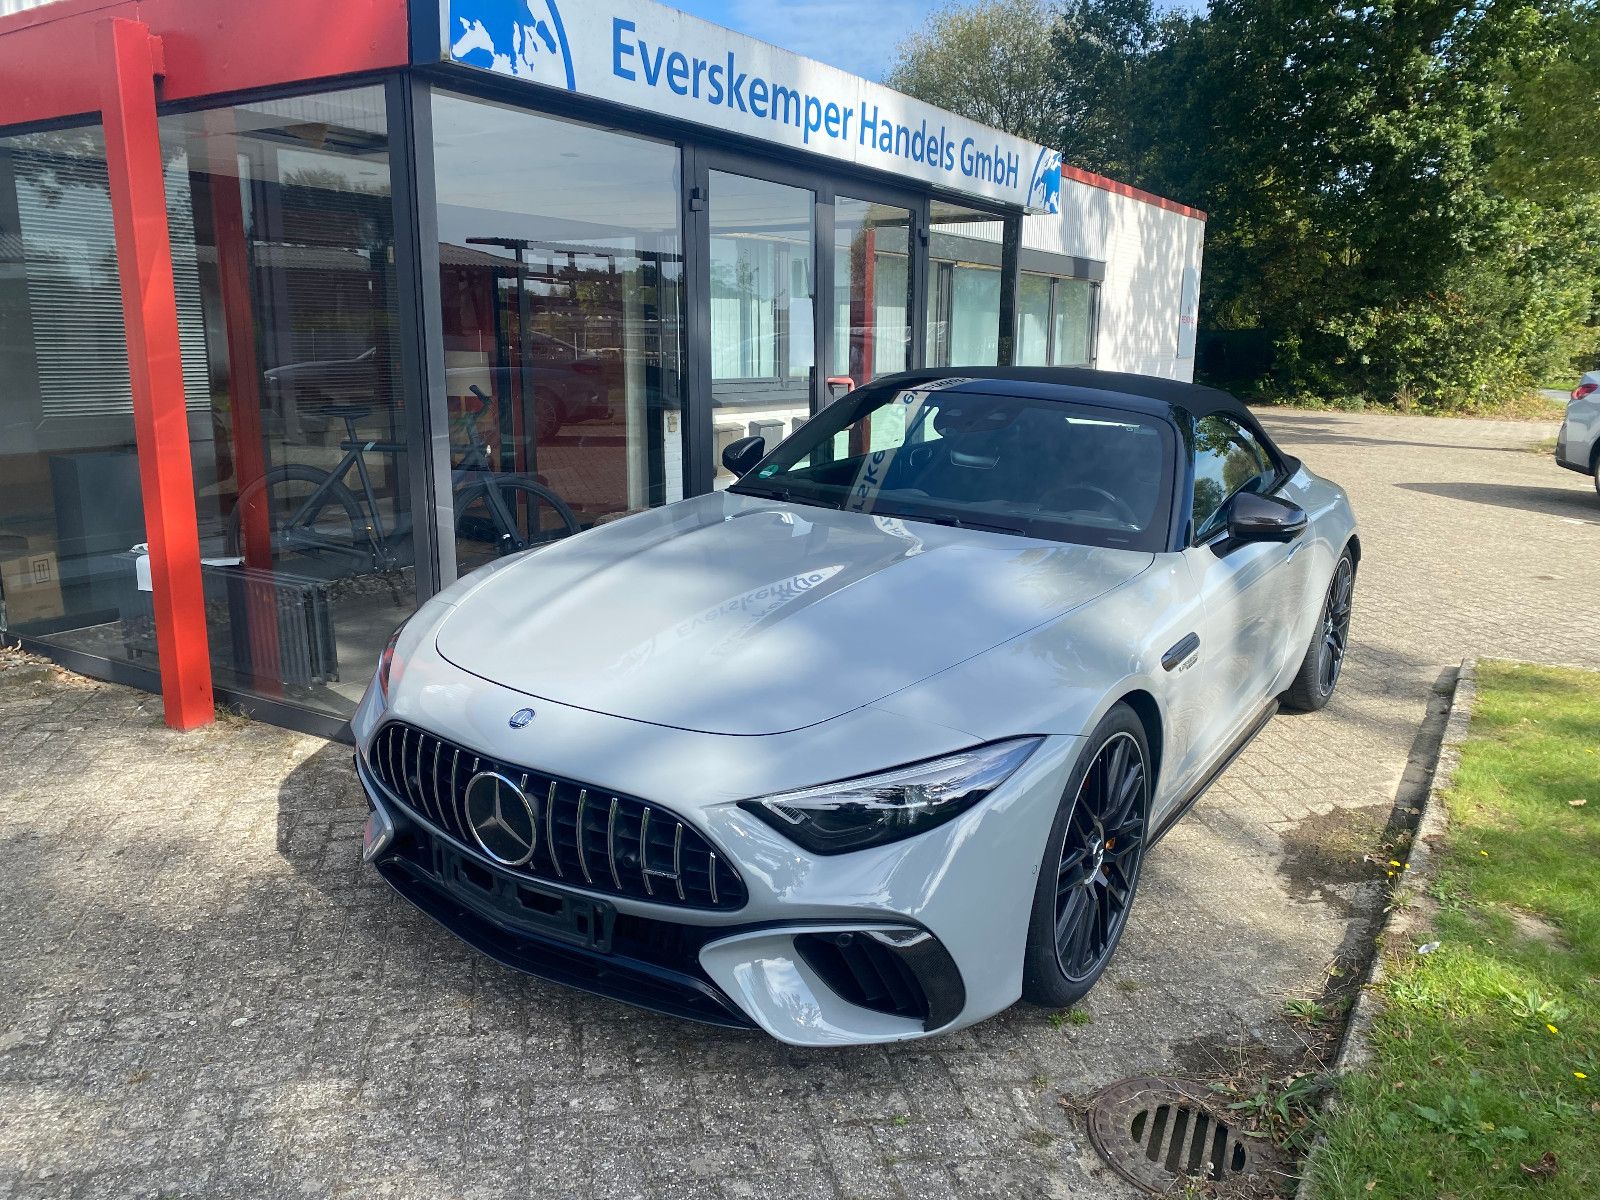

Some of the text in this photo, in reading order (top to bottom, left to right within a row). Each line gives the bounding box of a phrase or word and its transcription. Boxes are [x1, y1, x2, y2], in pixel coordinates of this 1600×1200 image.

[613, 17, 1020, 188] Everskemper Handels GmbH
